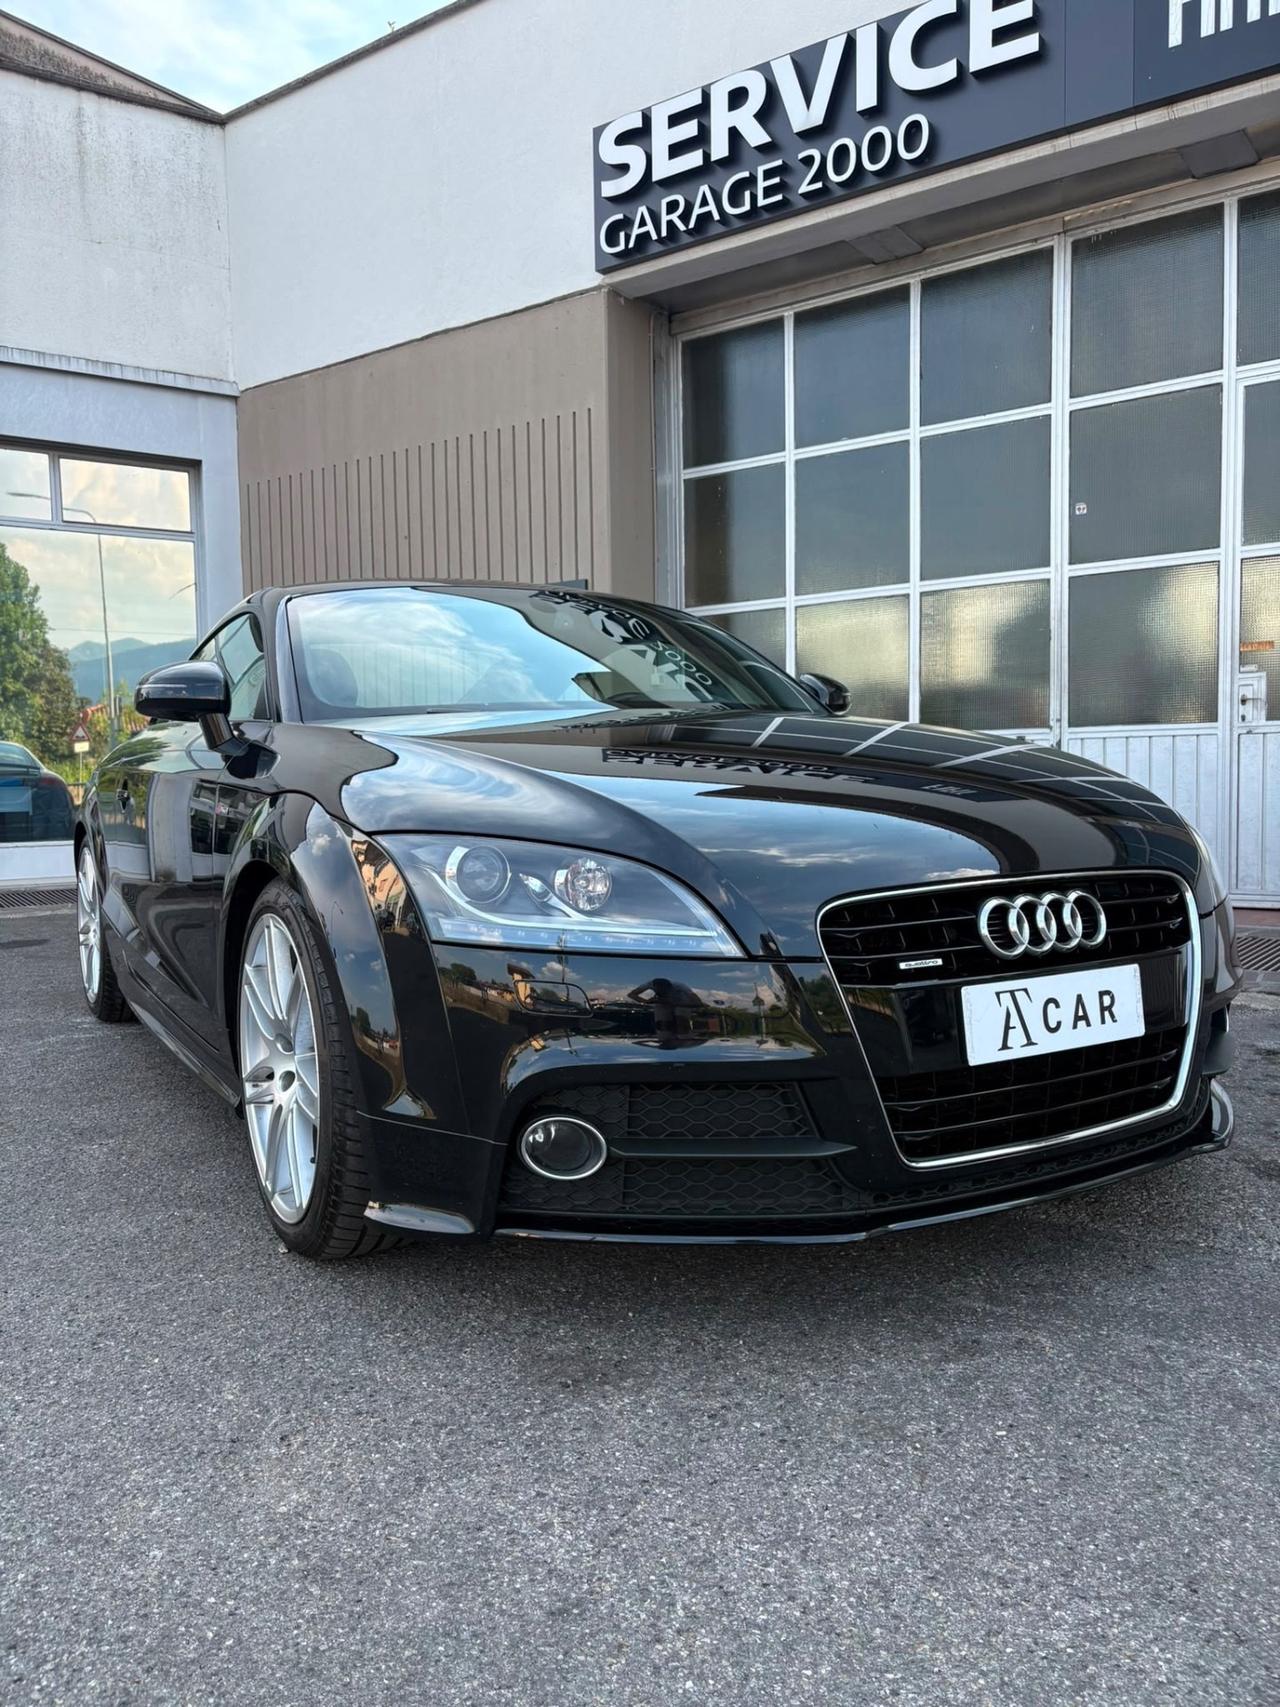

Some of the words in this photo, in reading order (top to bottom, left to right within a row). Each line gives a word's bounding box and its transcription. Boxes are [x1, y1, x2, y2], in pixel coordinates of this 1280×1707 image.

[598, 0, 1040, 199] SERVICE
[599, 159, 784, 255] GARAGE
[797, 113, 930, 194] 2000
[1042, 989, 1118, 1034] CAR
